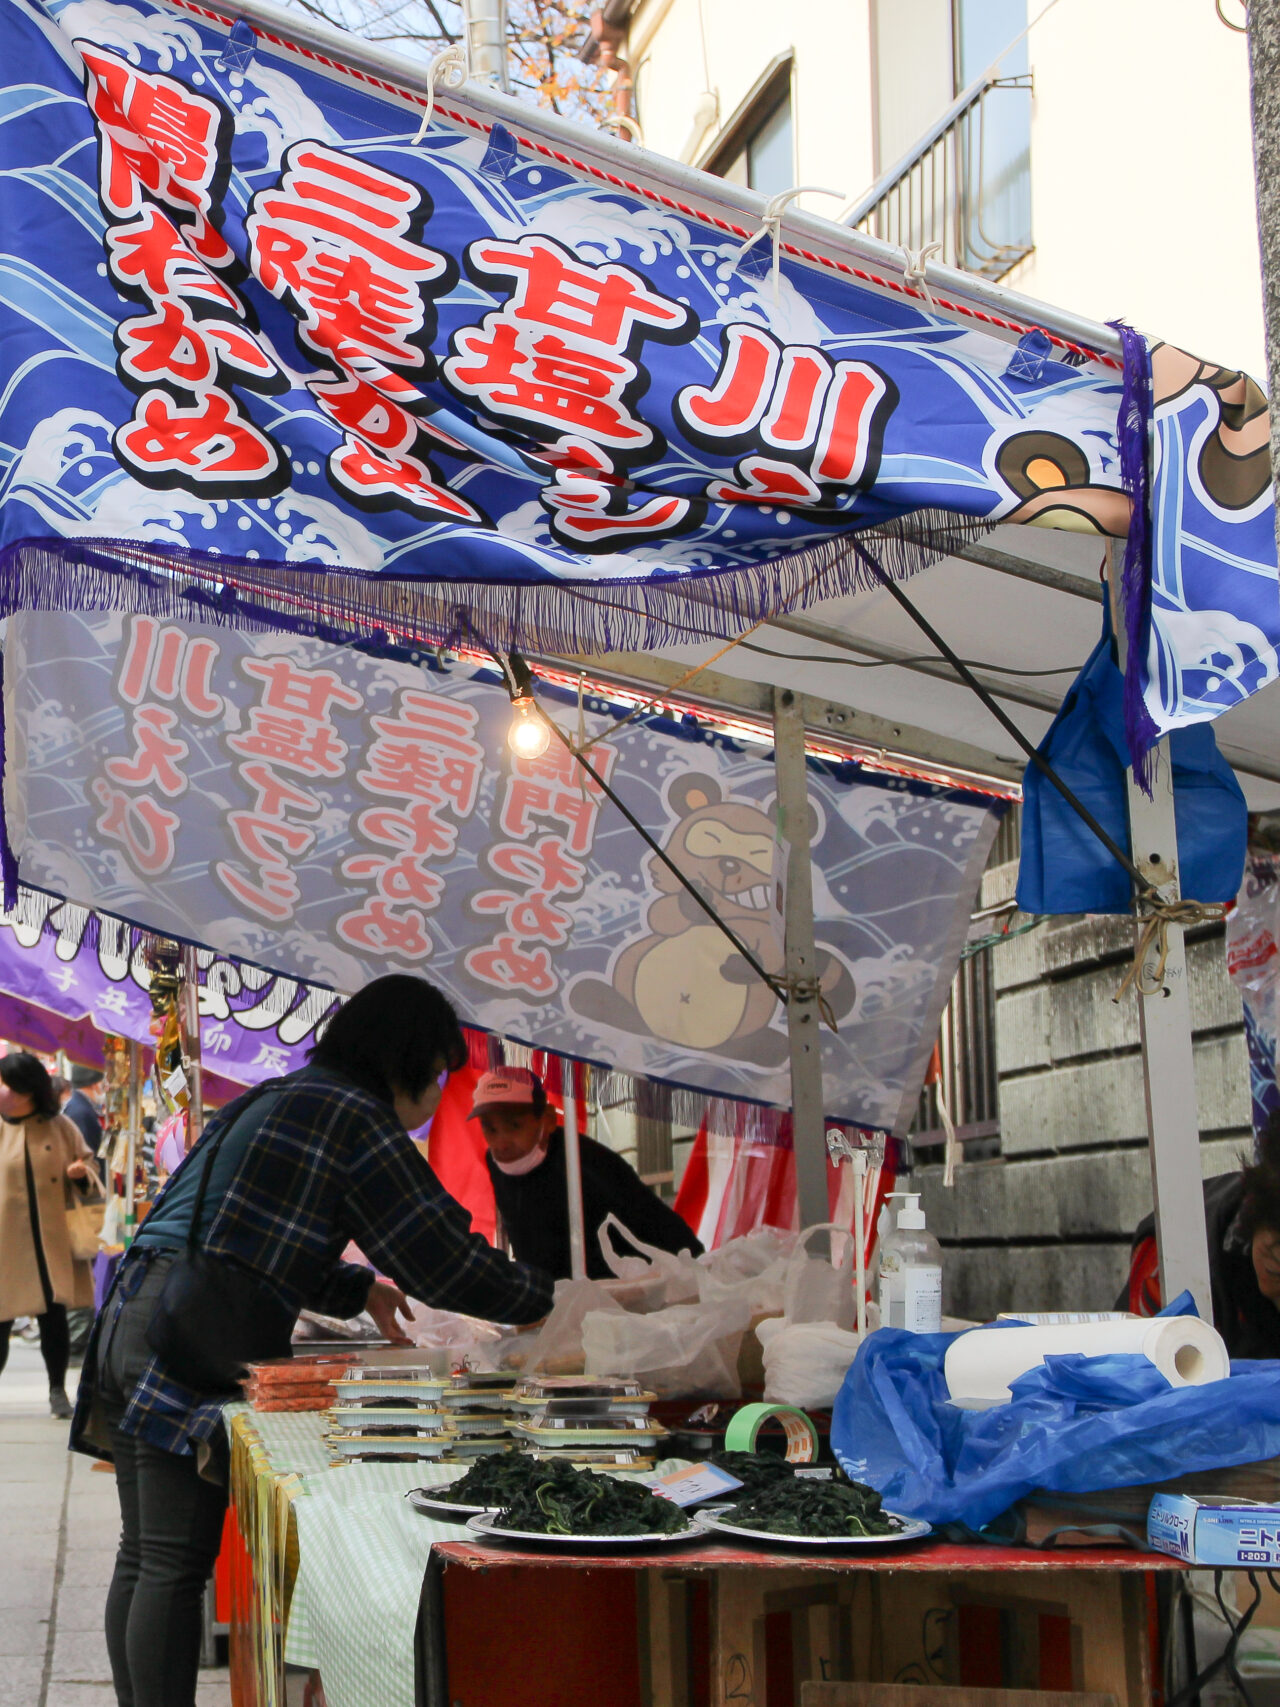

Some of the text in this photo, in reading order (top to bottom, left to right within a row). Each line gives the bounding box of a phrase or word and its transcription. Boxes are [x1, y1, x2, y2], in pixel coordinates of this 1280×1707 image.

[49, 966, 78, 992] 子
[203, 1023, 232, 1056] 卯
[1239, 1528, 1280, 1548] ニト
